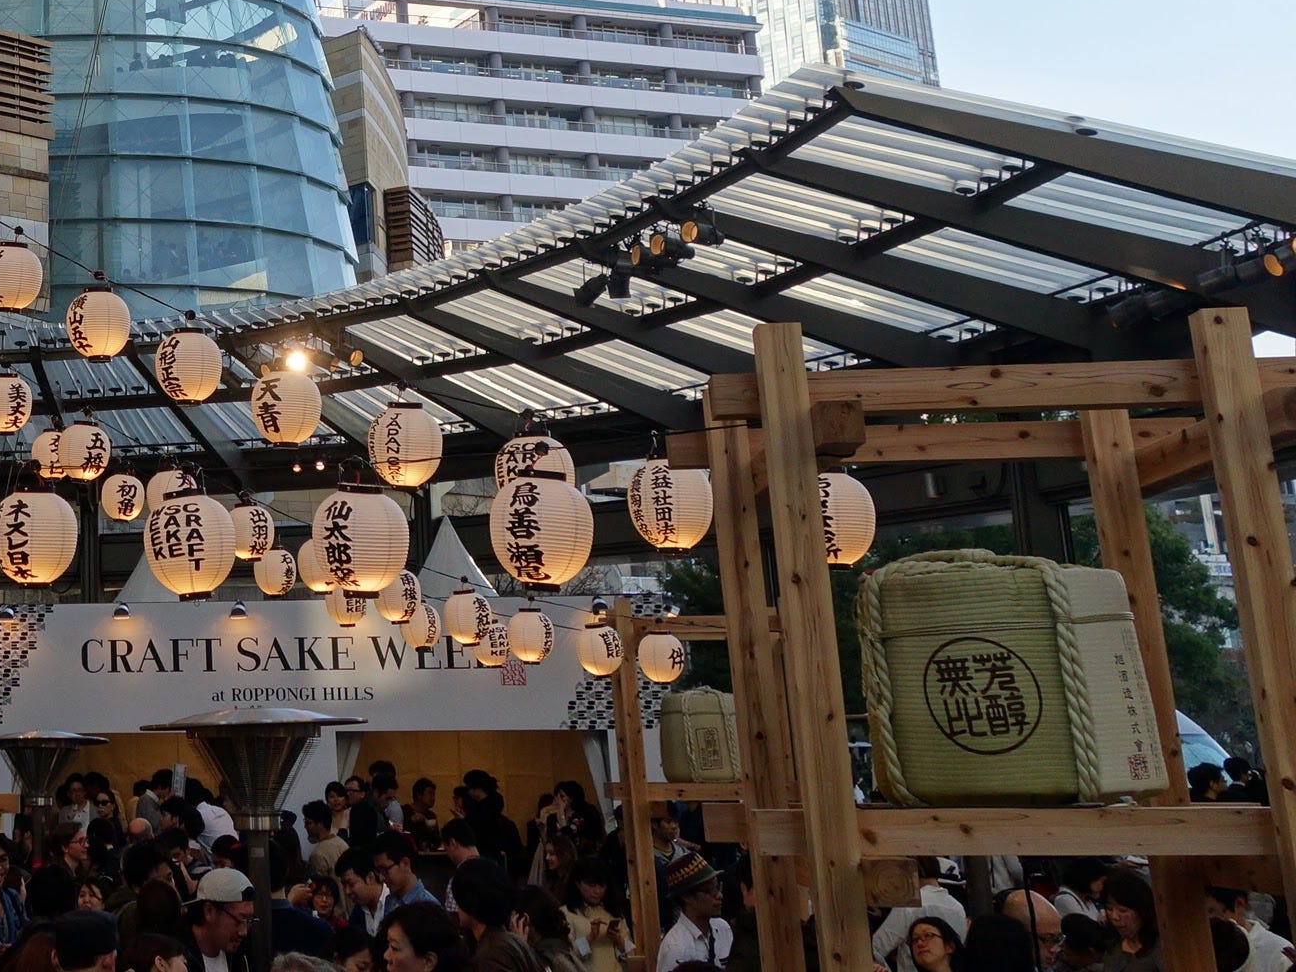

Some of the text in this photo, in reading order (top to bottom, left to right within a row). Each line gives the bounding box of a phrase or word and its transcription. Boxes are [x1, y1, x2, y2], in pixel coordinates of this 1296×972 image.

[158, 336, 189, 398] 山形正宗
[2, 383, 27, 429] 美丈夫
[255, 377, 282, 434] 天青
[80, 432, 106, 475] 五橋
[385, 412, 402, 454] JAPAN
[116, 480, 137, 517] 初亀
[3, 499, 38, 579] ネスレ日本
[149, 506, 168, 561] WEEK
[164, 503, 186, 558] SAKE
[182, 503, 205, 571] CRAFT
[248, 509, 268, 556] 出羽桜
[400, 573, 419, 619] 雨後の月
[81, 635, 498, 674] CRAFT SAKE WEE
[211, 687, 374, 702] at ROPPONGI HILLS
